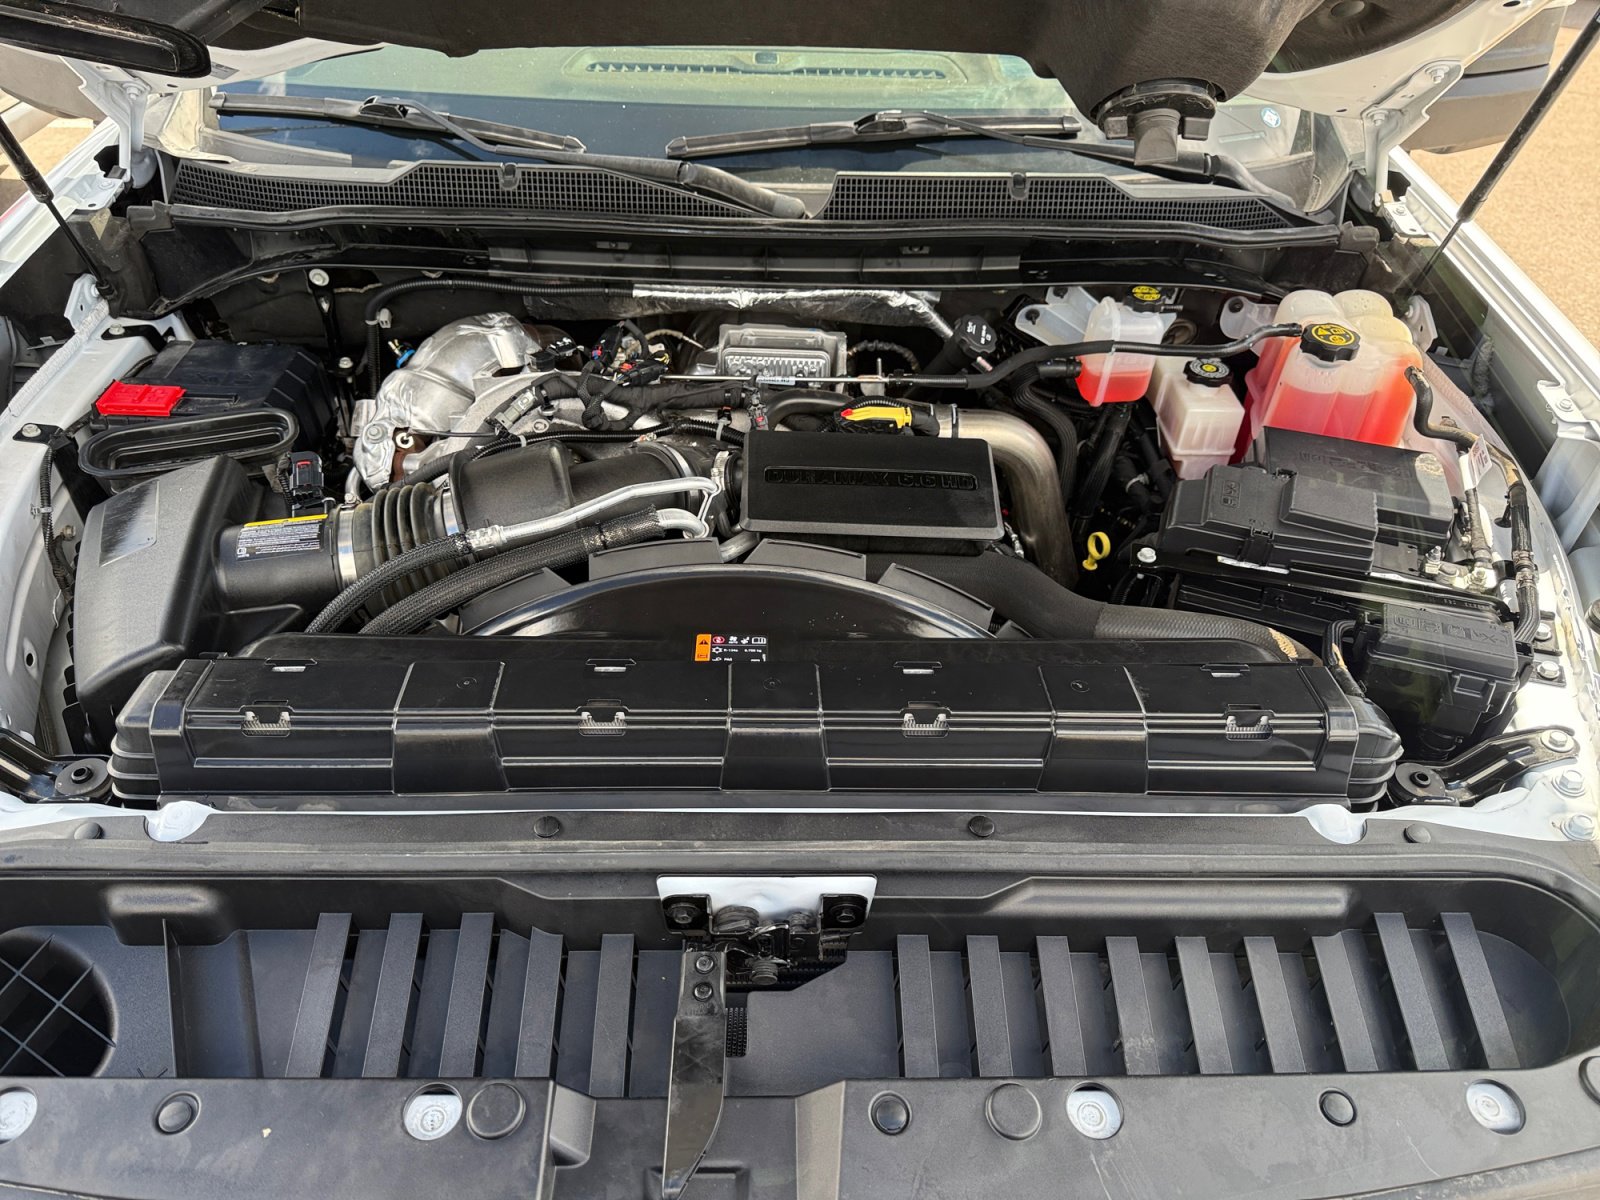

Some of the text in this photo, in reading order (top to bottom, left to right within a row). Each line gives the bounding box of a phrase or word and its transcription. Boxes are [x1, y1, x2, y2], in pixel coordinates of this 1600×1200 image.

[767, 468, 975, 490] DURAMAX 6.6 HD
